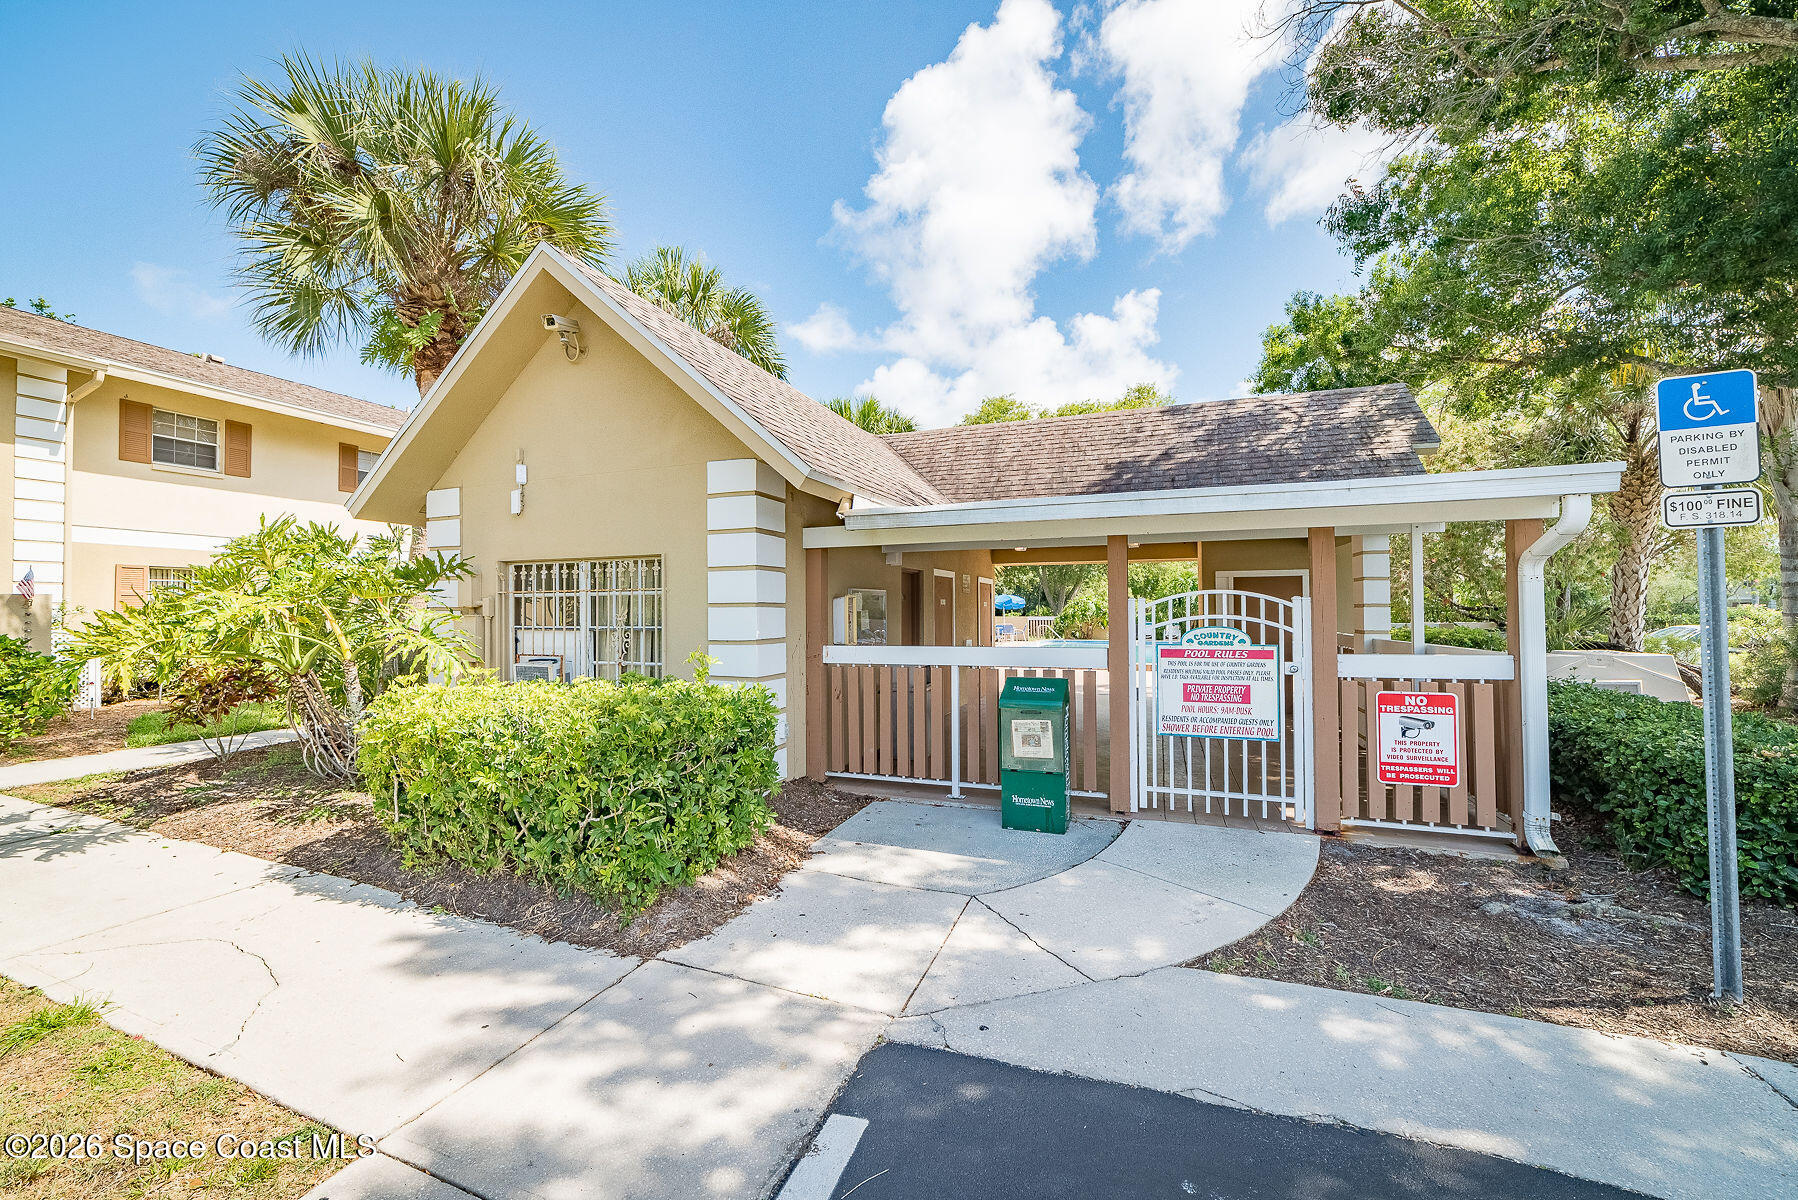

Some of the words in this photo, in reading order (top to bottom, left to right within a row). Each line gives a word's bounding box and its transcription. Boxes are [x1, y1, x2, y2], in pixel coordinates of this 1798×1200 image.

[1670, 432, 1724, 444] PARKING
[1729, 429, 1745, 438] BY
[1678, 443, 1738, 456] DISABLED
[1686, 456, 1731, 467] PERMIT
[1693, 470, 1726, 480] ONLY
[1717, 497, 1754, 510] FINE
[1705, 510, 1743, 519] 318.14
[1193, 632, 1239, 640] COUNTRY
[1184, 650, 1210, 658] POOL
[1214, 650, 1249, 659] RULES
[1186, 684, 1213, 694] PRIVATE
[1214, 686, 1246, 694] PROPERTY
[1190, 692, 1200, 701] NO
[1200, 693, 1242, 702] TRESPASSING
[1404, 696, 1428, 706] NO
[1181, 704, 1196, 713] POOL
[1198, 706, 1220, 714] HOURS:
[1220, 706, 1253, 716] 9AM-DUSK
[1380, 704, 1454, 714] TRESPASSING
[1161, 714, 1190, 723] RESIDENTS
[1198, 716, 1238, 725] ACCOMPANIED
[1238, 718, 1258, 726] GUESTS
[1258, 718, 1275, 727] ONLY
[1162, 722, 1190, 732] SHOWER
[1192, 724, 1218, 734] BEFORE
[1220, 726, 1254, 736] ENTERING
[1256, 727, 1275, 737] POOL
[1406, 754, 1449, 763] SURVEILLANCE
[1380, 764, 1434, 774] TRESPASSERS
[1400, 773, 1450, 782] PROSECUTED
[1012, 794, 1040, 804] Hometown
[1040, 796, 1055, 806] News
